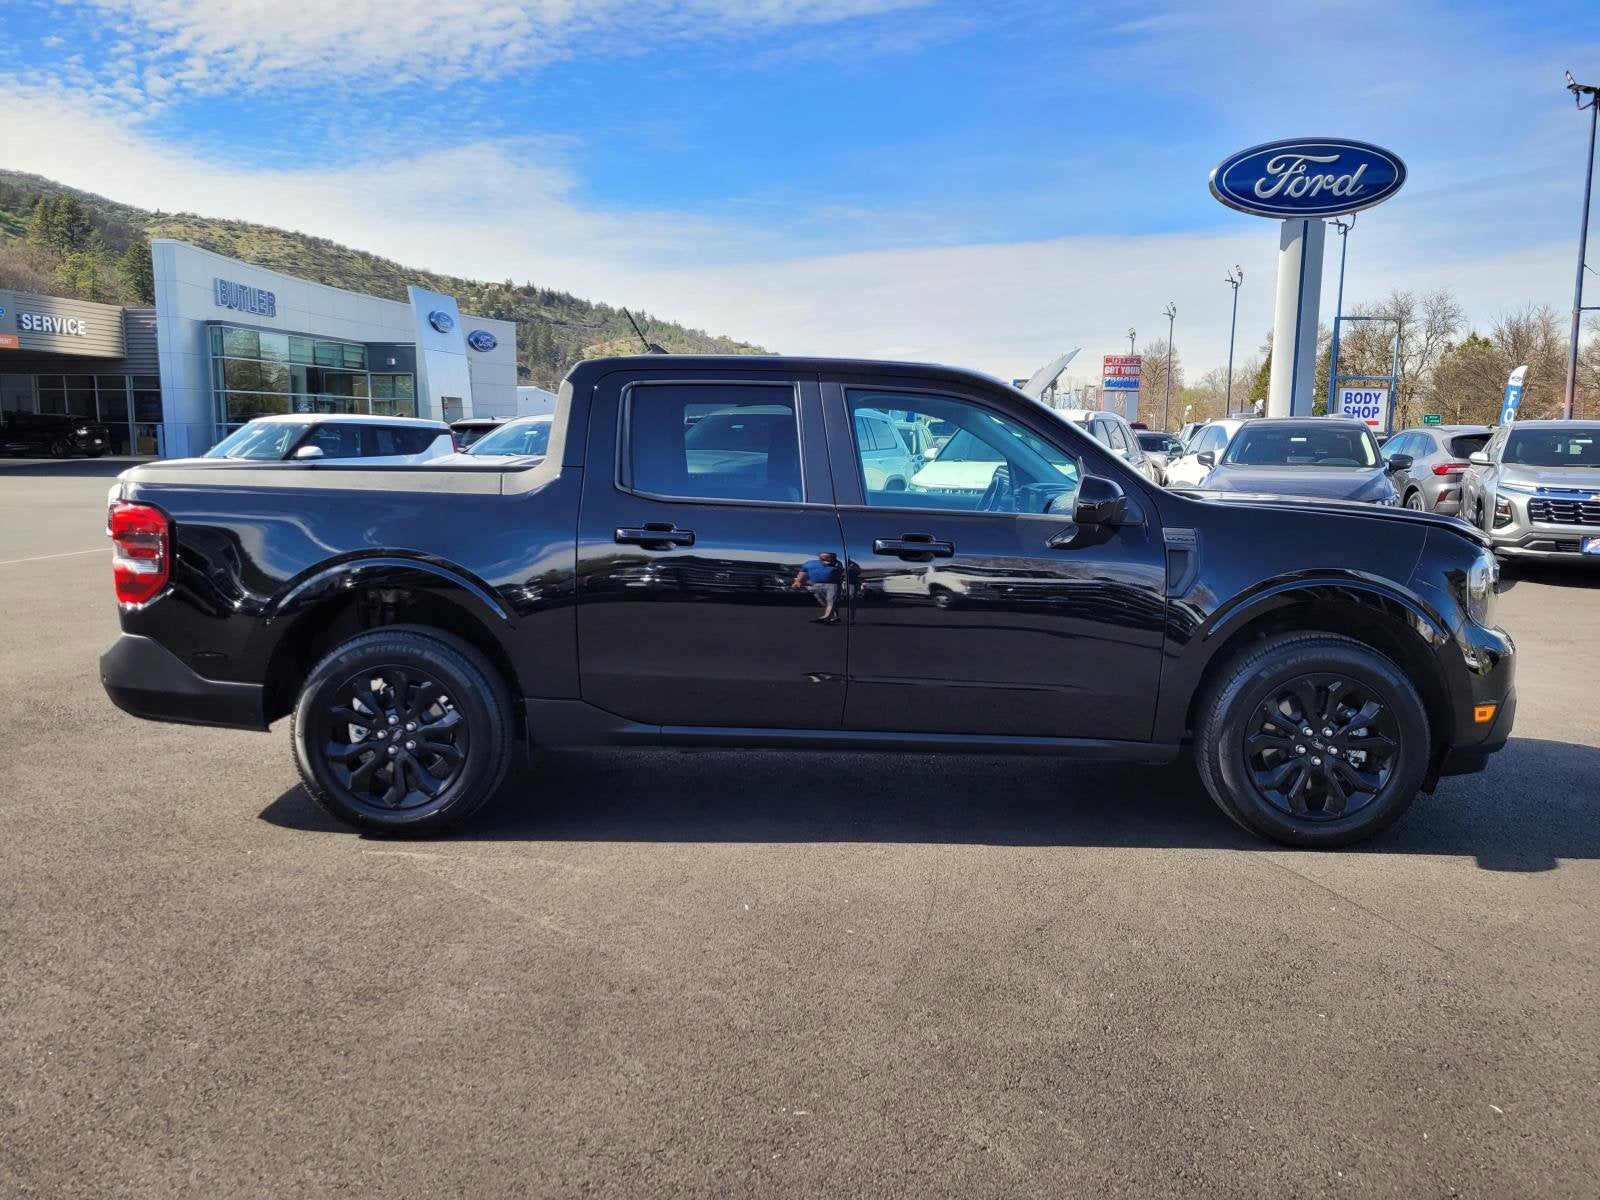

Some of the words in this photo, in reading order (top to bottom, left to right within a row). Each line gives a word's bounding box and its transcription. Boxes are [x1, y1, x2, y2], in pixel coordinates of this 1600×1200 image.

[1254, 154, 1368, 199] Ford
[214, 277, 276, 317] BUTLER
[22, 313, 87, 336] SERVICE
[1344, 391, 1382, 405] BODY
[1343, 405, 1380, 418] SHOP
